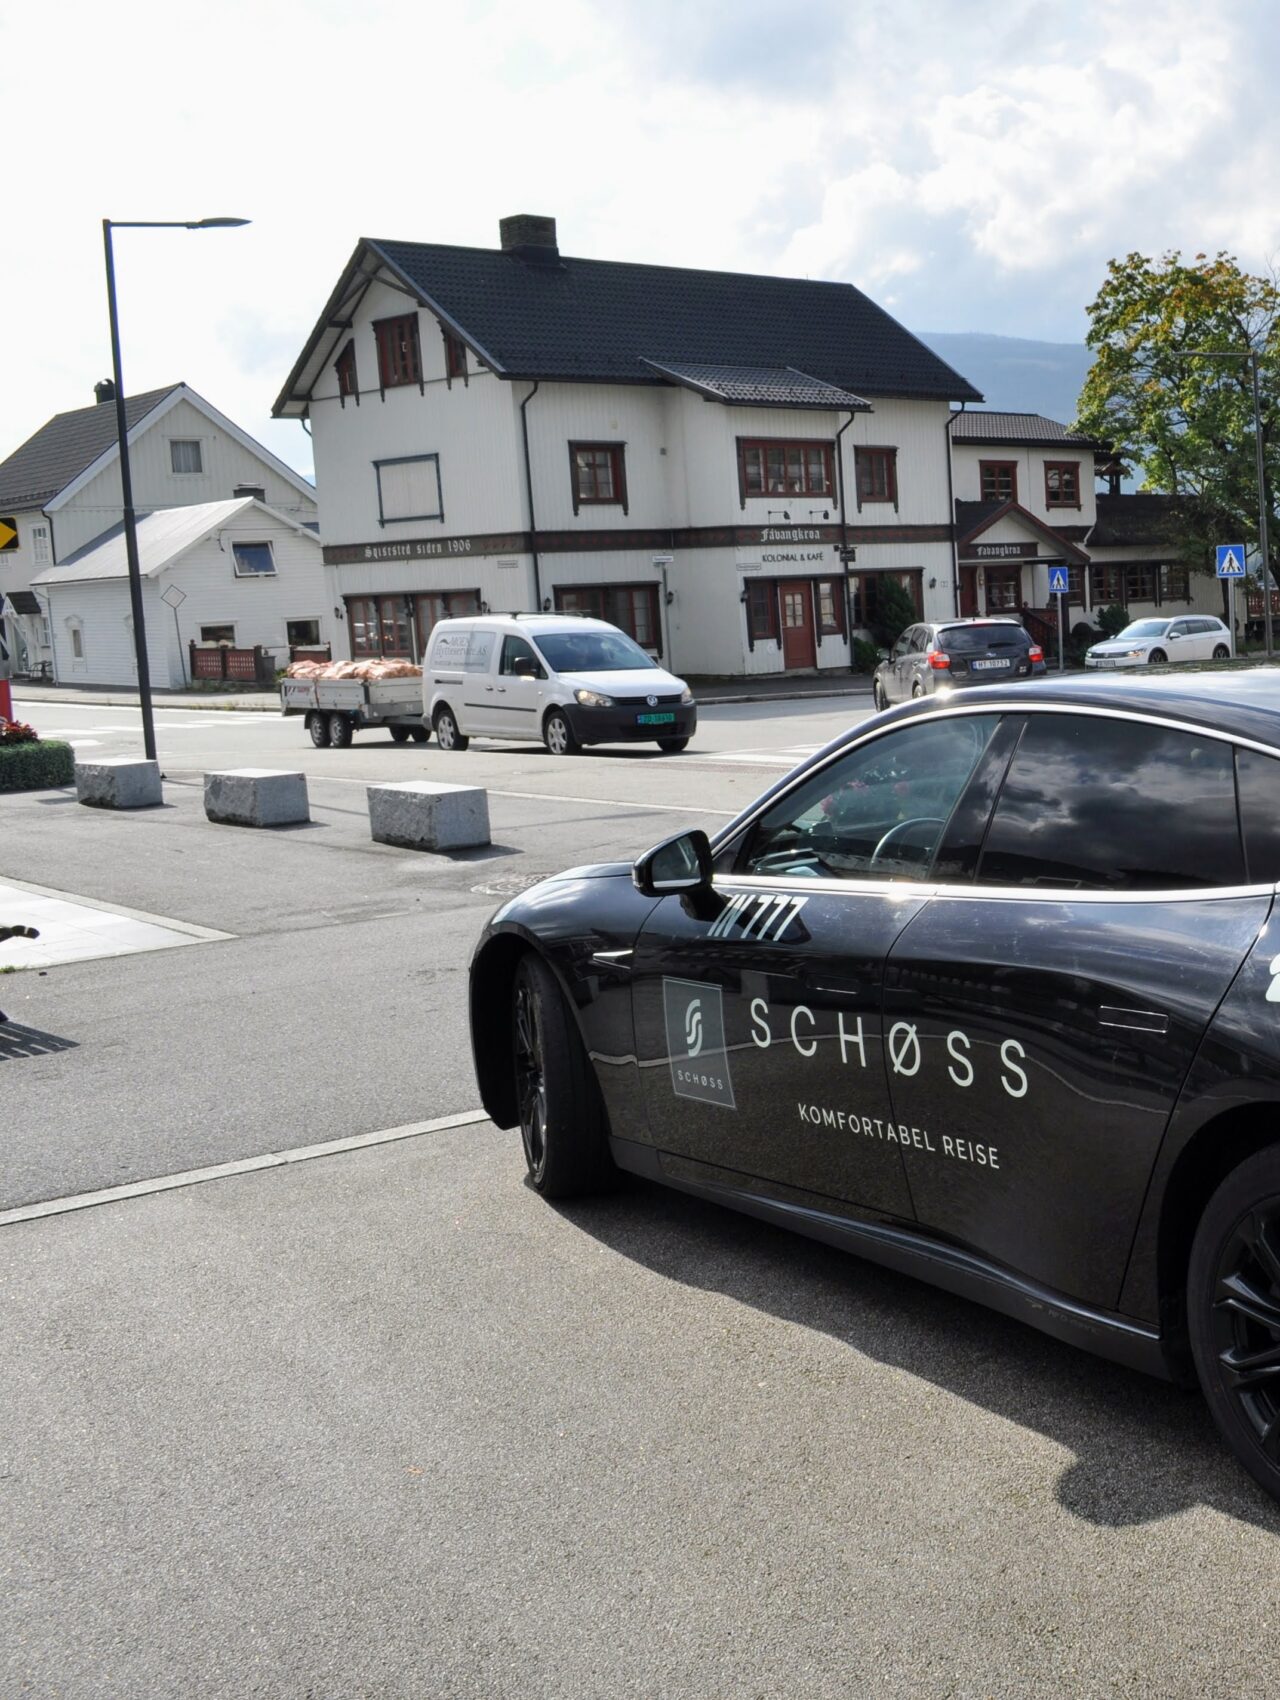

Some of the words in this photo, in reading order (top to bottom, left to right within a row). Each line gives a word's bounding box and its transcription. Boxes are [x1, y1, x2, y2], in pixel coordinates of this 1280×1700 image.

[416, 543, 442, 554] siden
[448, 539, 472, 552] 1906
[762, 553, 798, 563] KOLONIAL
[740, 894, 810, 942] 777
[750, 997, 1028, 1098] SCHØSS
[677, 1069, 723, 1090] SCHØSS
[798, 1102, 936, 1152] KOMFORTABEL
[942, 1134, 1000, 1169] REISE
